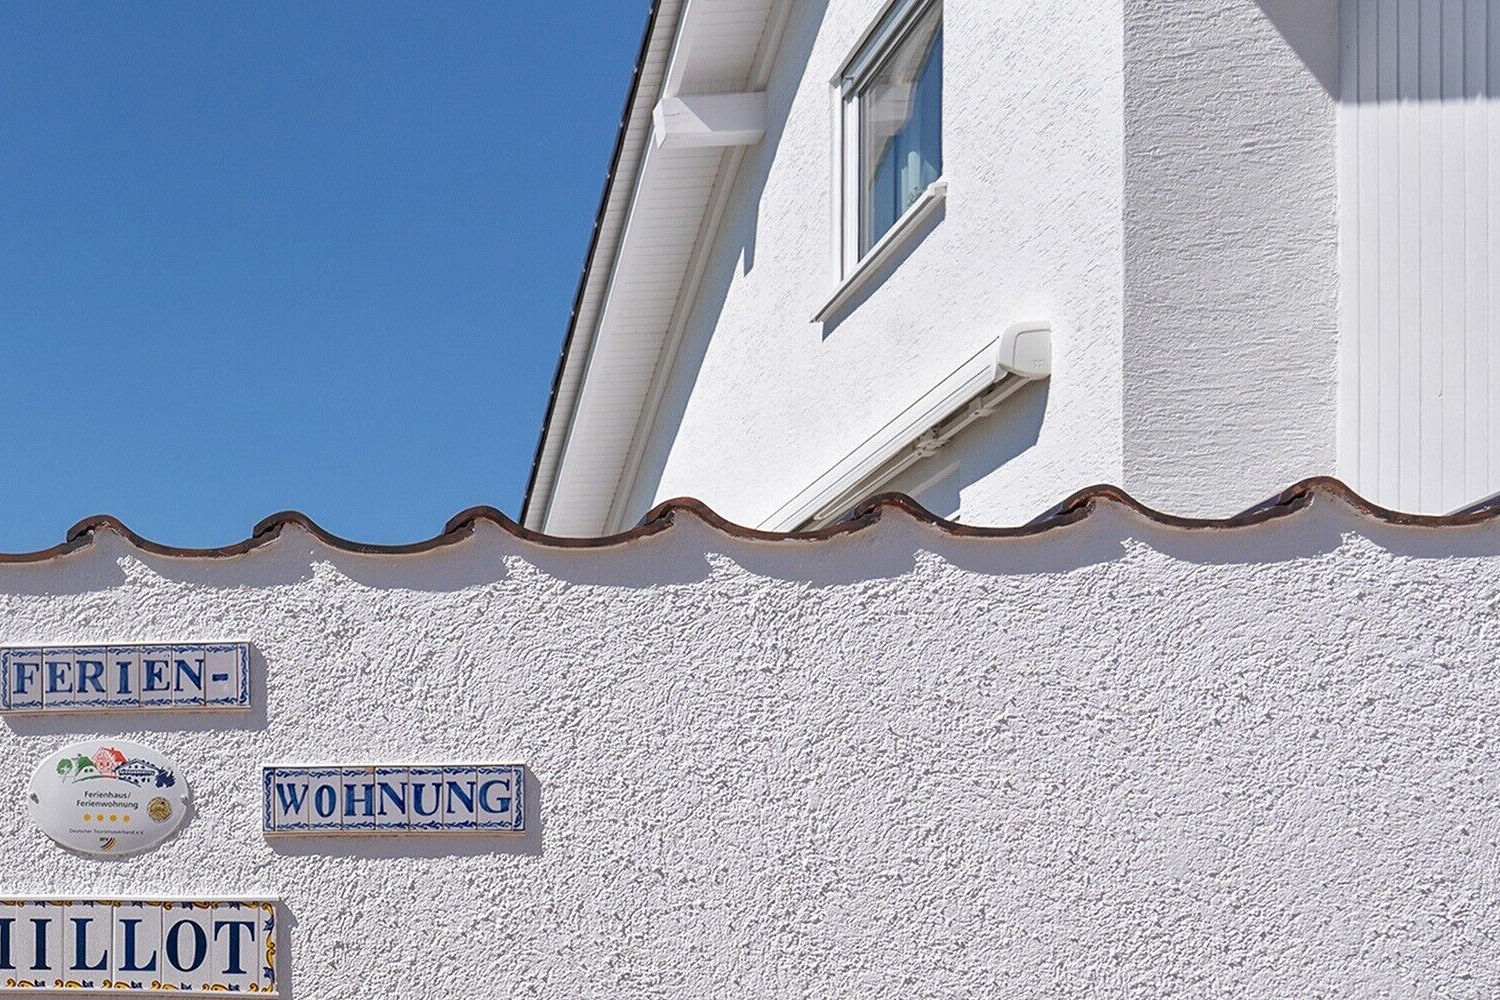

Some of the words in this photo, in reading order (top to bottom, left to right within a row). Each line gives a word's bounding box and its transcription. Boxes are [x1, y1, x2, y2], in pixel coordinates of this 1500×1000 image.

[12, 658, 229, 695] FERIEN-
[76, 800, 138, 810] Ferienwohnung
[84, 791, 131, 799] Ferienhaus/
[276, 779, 511, 818] WOHNUNG
